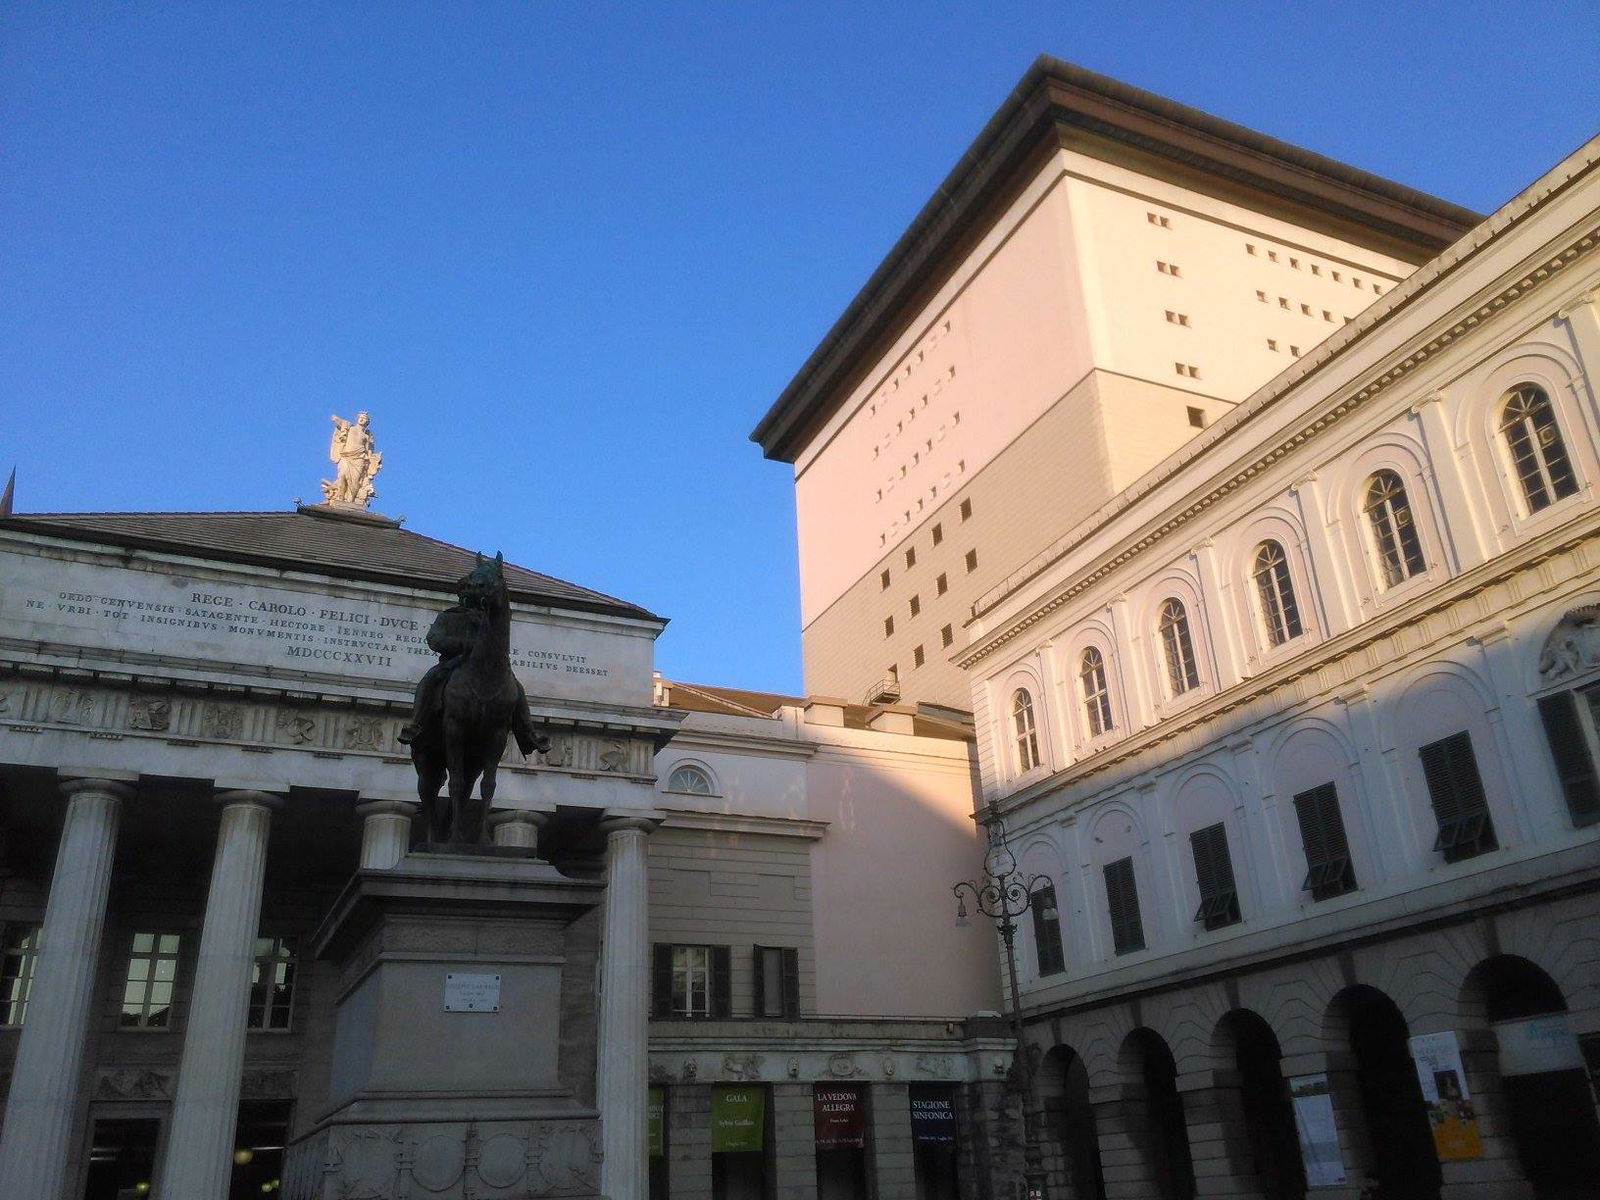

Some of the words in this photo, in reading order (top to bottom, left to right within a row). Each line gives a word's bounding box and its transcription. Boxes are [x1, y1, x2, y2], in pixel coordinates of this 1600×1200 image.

[191, 592, 233, 607] REGE
[248, 600, 306, 617] CAROLO
[319, 609, 370, 625] FELICI
[379, 617, 419, 631] DVCE
[59, 592, 92, 603] ORDO
[101, 597, 174, 614] GENVENSIS
[185, 608, 259, 624] SATAGENTE
[270, 619, 325, 632] HECTORE
[528, 650, 587, 664] CONSVLVIT
[26, 600, 45, 609] NE
[57, 603, 91, 615] VRBI
[103, 609, 128, 619] TOT
[140, 614, 217, 631] INSIGNIBVS
[228, 625, 314, 642] MONVMENTIS
[324, 637, 398, 652] INSTRVCTAE
[512, 659, 558, 671] ABILIVS
[566, 665, 608, 677] DEESSET
[287, 646, 392, 667] MDCCCXXVII
[726, 1094, 747, 1103] GALA
[817, 1093, 827, 1101] LA
[828, 1092, 857, 1101] VEDOVA
[822, 1104, 855, 1112] ALLEGRA
[912, 1100, 951, 1109] STAGIONE
[912, 1111, 954, 1120] SINFONICA
